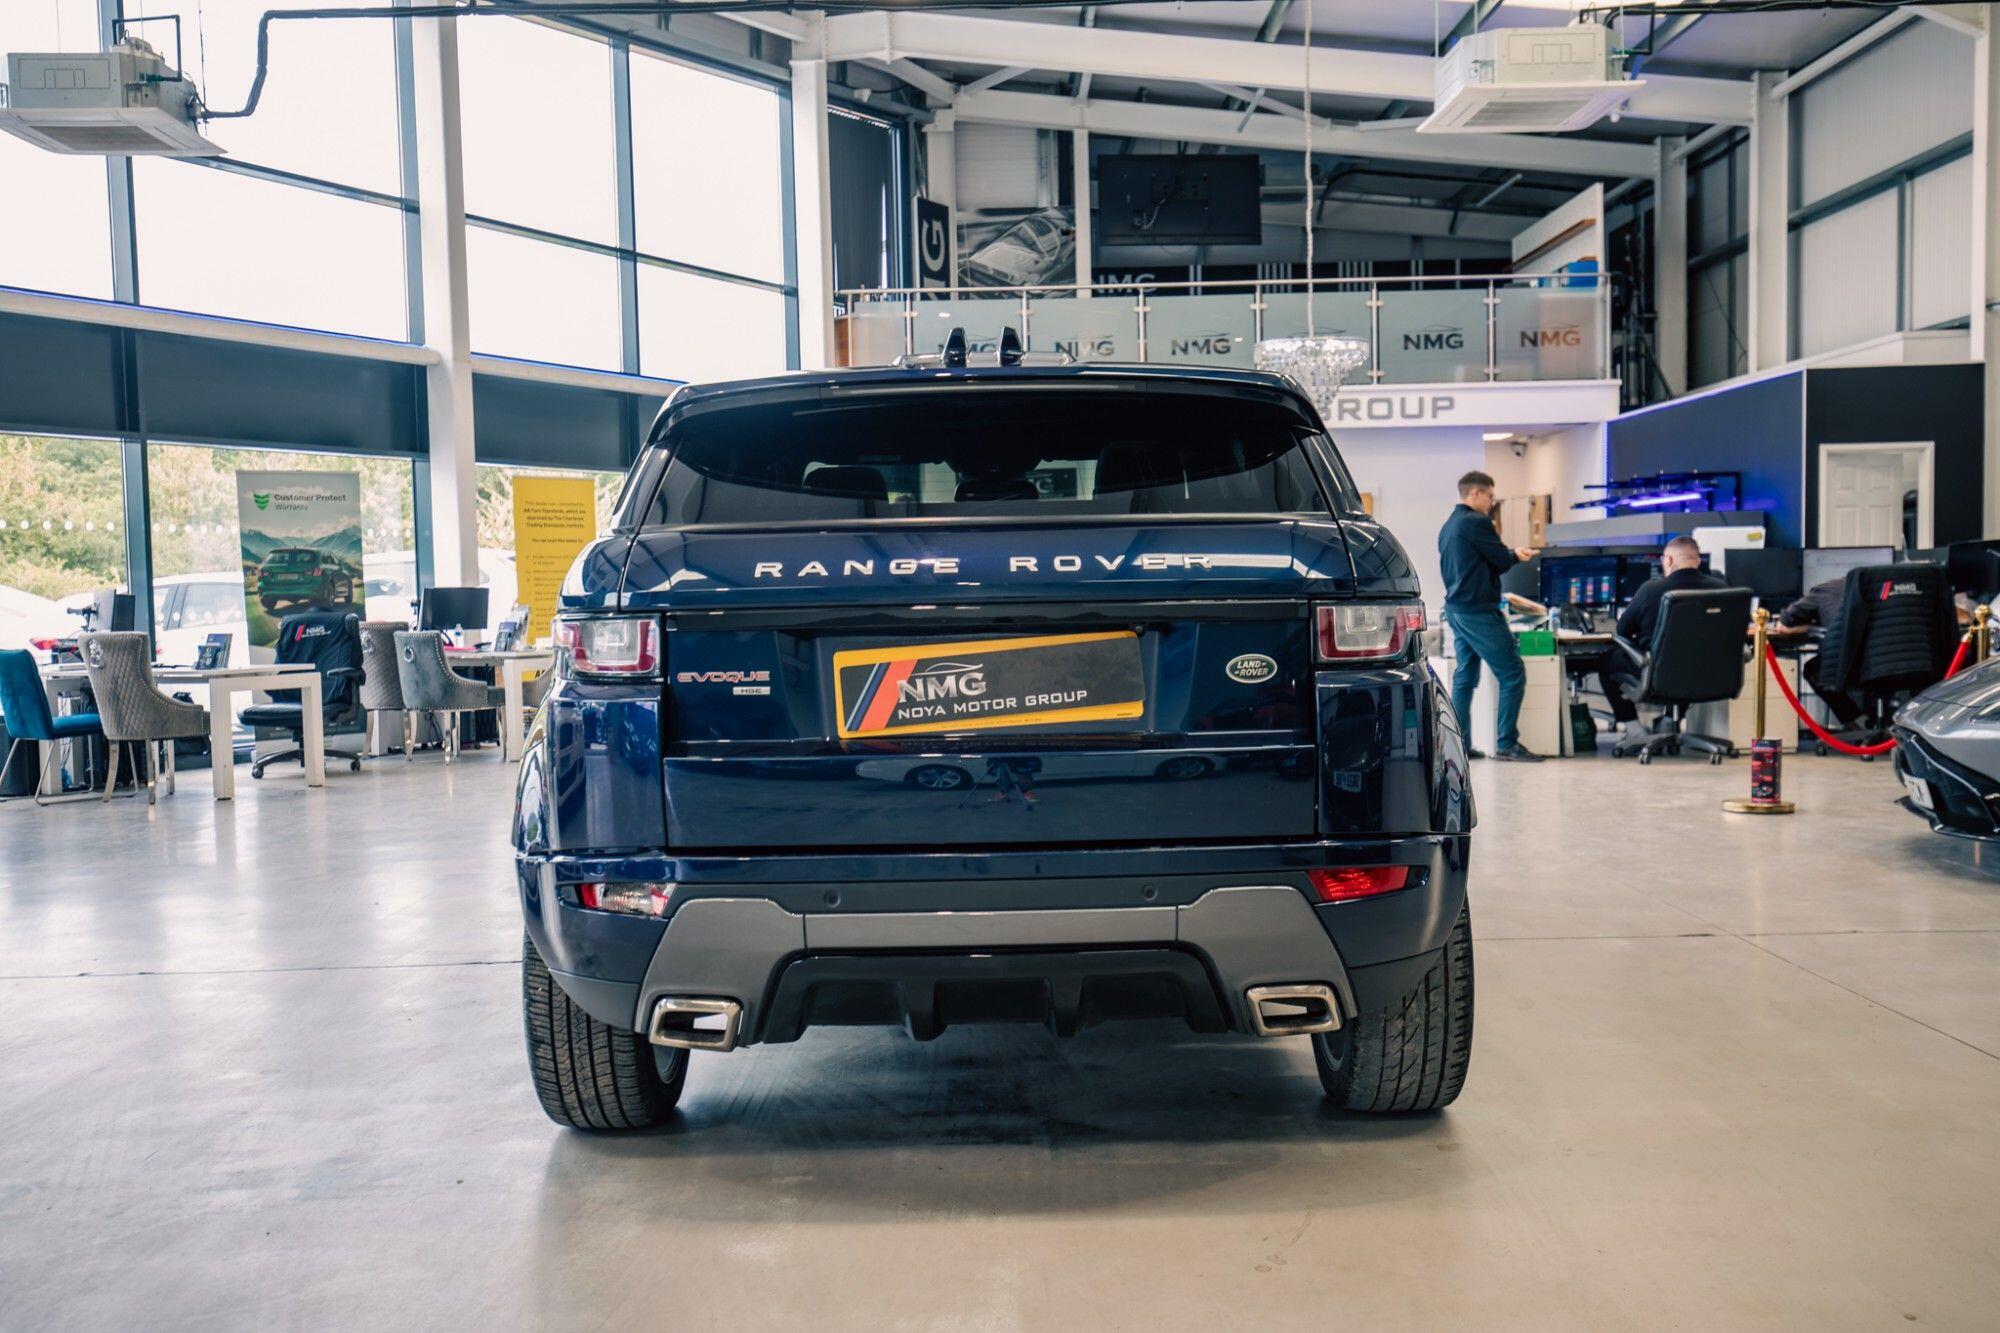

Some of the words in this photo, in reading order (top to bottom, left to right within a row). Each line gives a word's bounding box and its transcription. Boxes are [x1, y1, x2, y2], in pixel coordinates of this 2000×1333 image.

[1171, 337, 1231, 355] NMG
[1404, 332, 1464, 351] NMG
[1520, 329, 1581, 350] NMG
[274, 493, 314, 502] Customer
[315, 494, 346, 502] Protect
[274, 503, 309, 511] Warranty
[754, 557, 960, 579] RANGE
[1009, 553, 1215, 573] ROVER
[1237, 660, 1261, 669] LAND
[1239, 667, 1268, 677] ROVER
[677, 671, 770, 683] EVOQUE
[740, 687, 762, 695] HSE
[896, 671, 987, 703] NMG
[897, 705, 946, 720] NOYA
[952, 697, 1018, 714] MOTOR
[1024, 689, 1088, 706] GROUP
